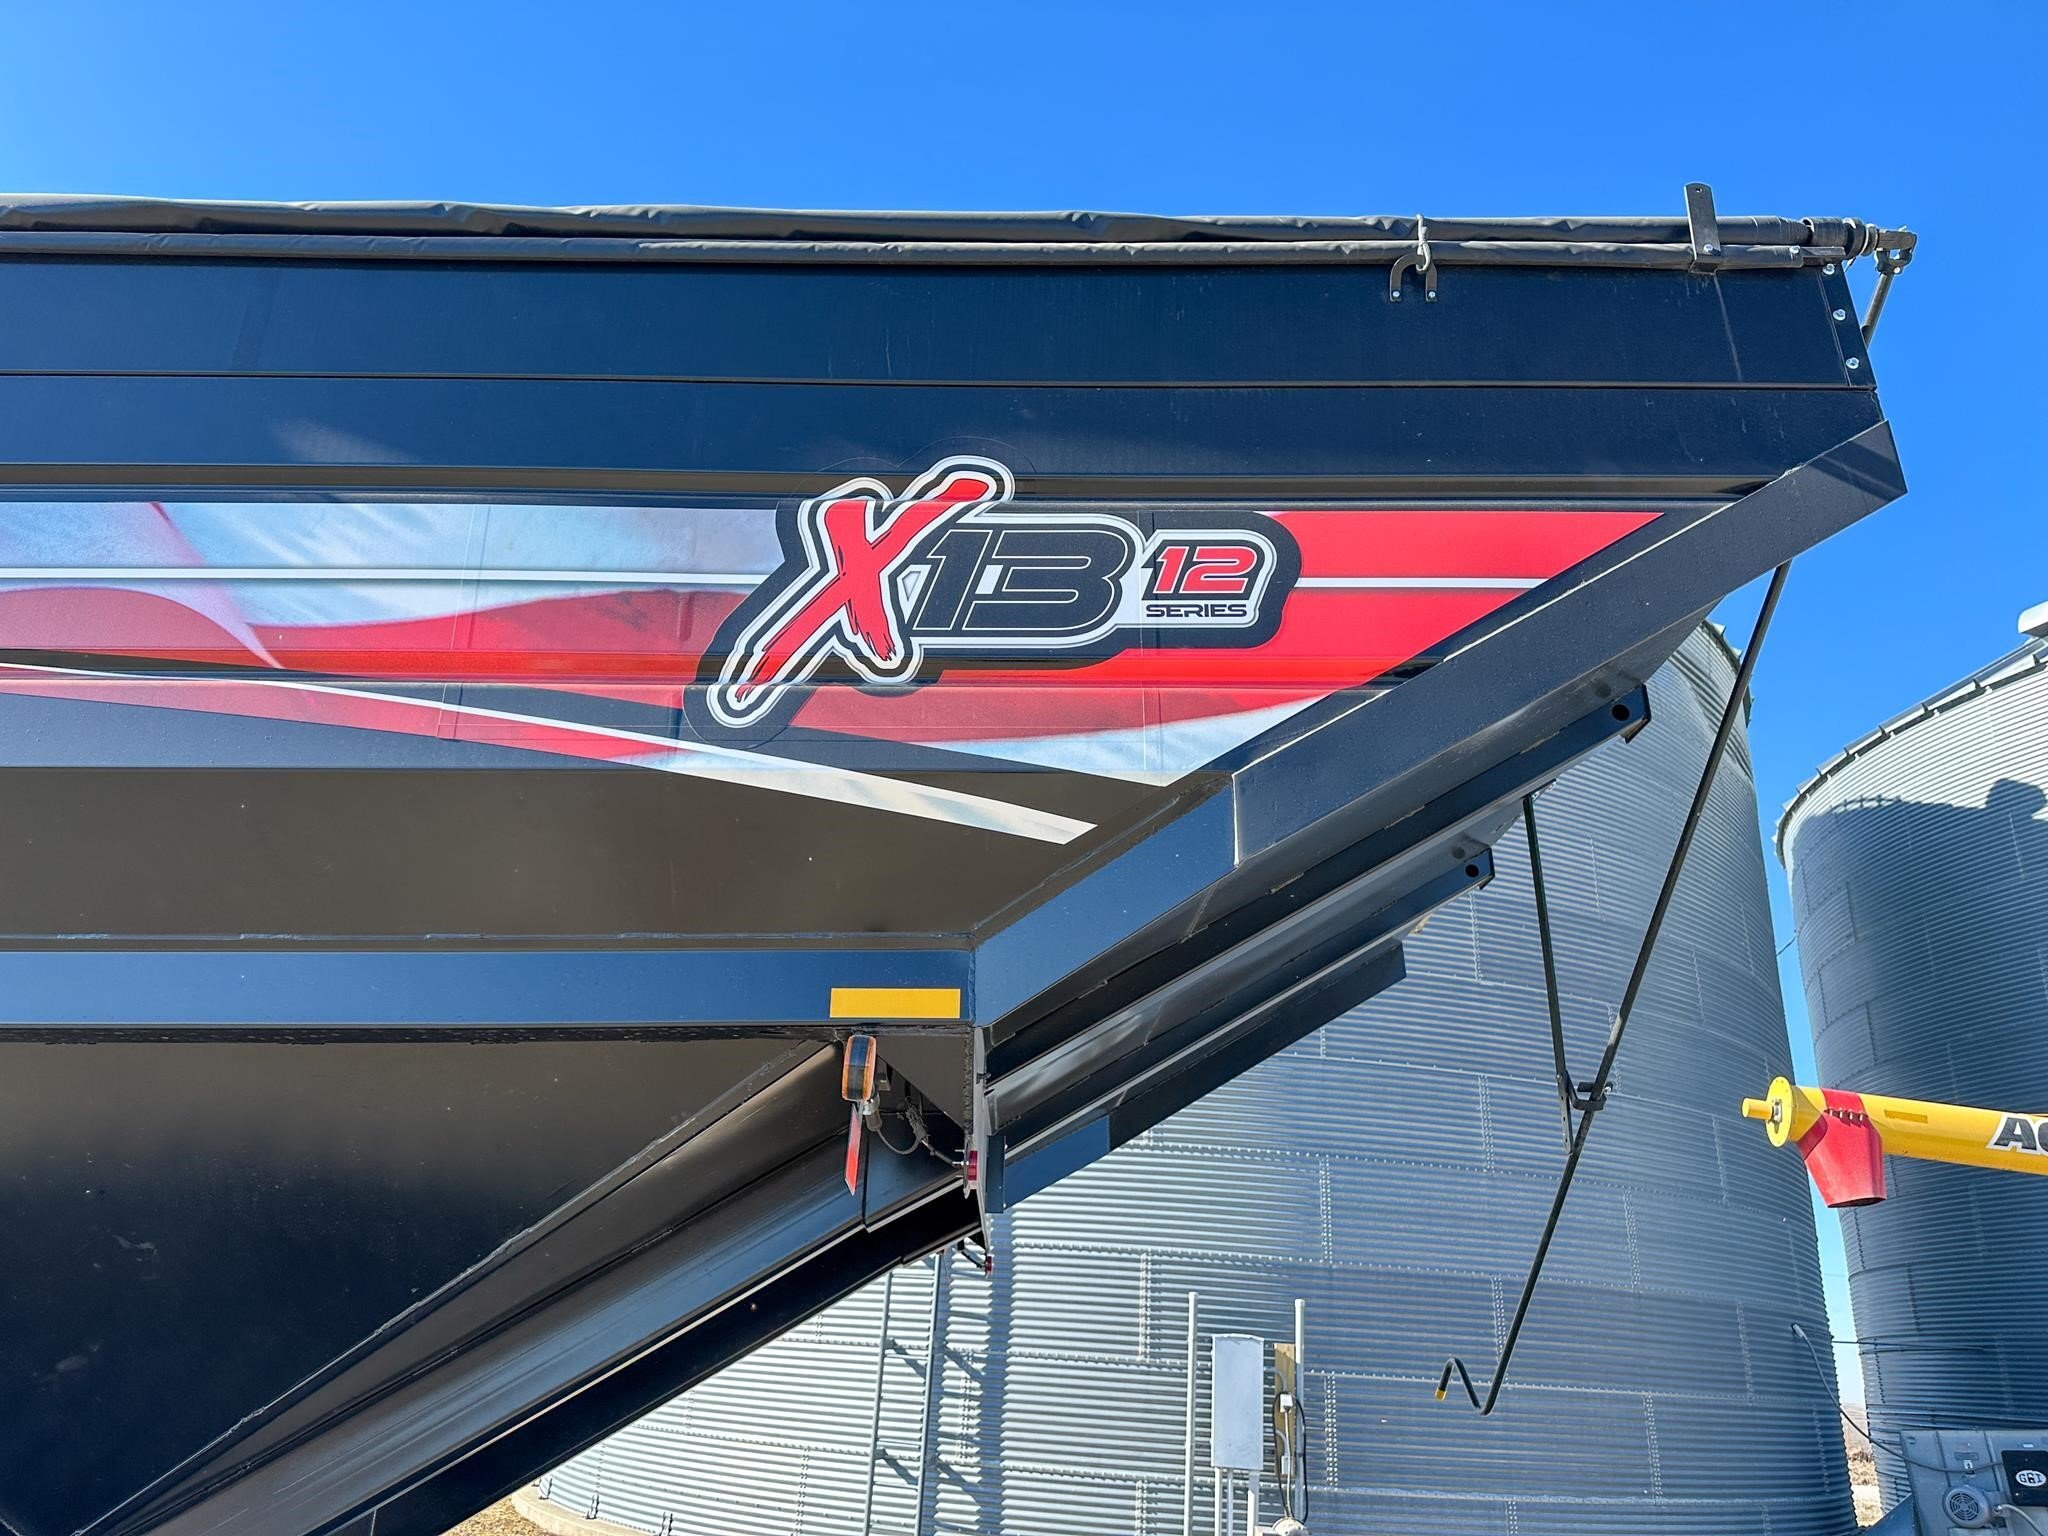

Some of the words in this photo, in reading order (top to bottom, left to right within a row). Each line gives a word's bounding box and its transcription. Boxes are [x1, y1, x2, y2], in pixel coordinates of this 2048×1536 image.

[735, 478, 1128, 703] X13
[1153, 546, 1257, 593] 12
[1146, 604, 1247, 617] SERIES
